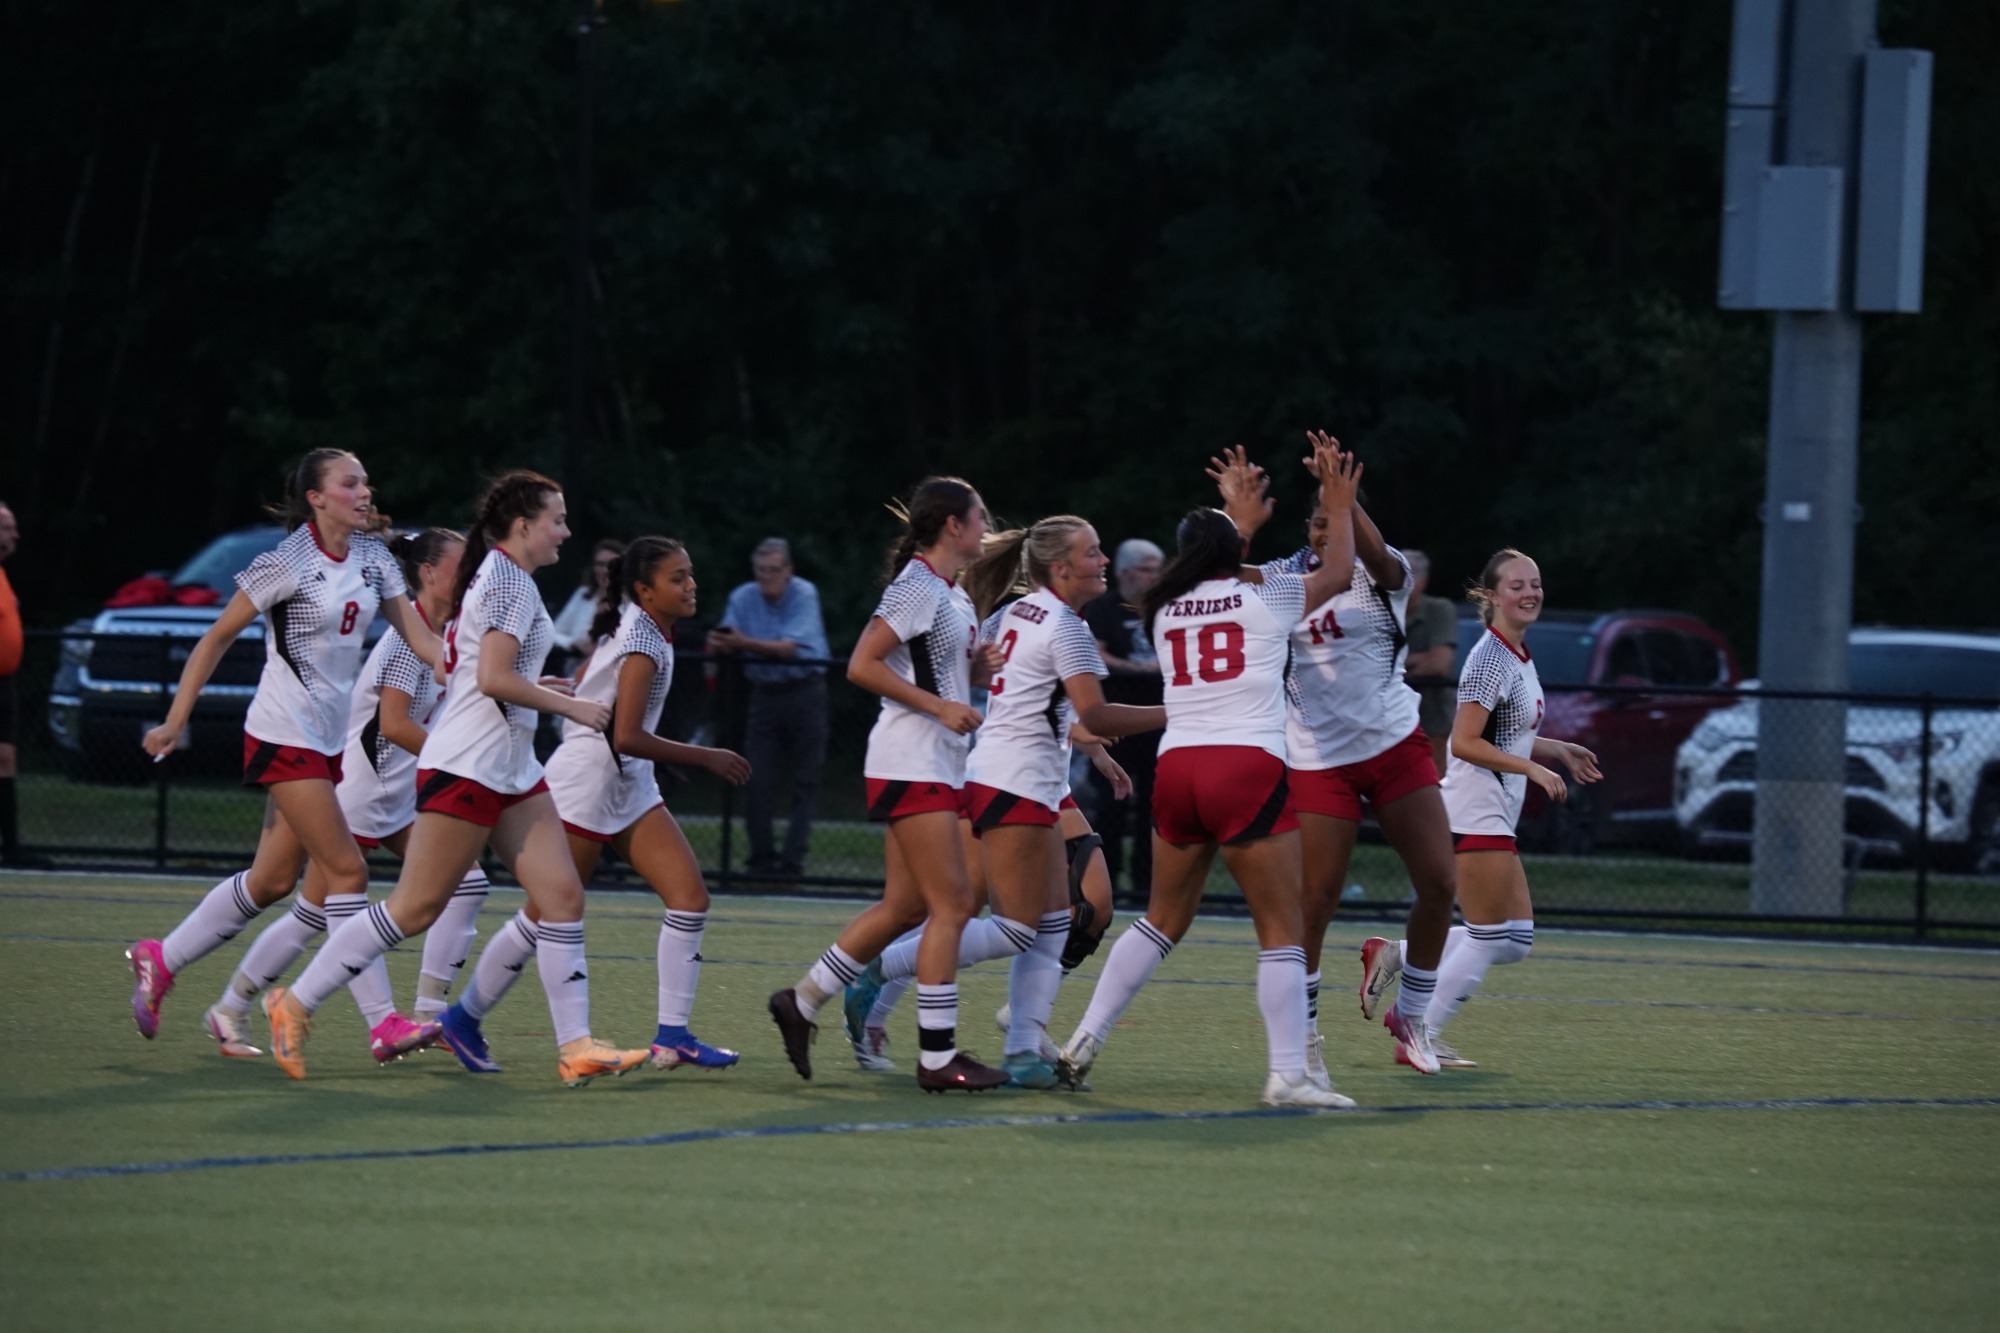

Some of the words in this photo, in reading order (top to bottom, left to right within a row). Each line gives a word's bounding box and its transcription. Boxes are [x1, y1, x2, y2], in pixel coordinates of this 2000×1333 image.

[340, 601, 359, 635] 8
[1165, 594, 1242, 617] TERRIERS
[1309, 609, 1345, 645] 14
[1164, 621, 1245, 687] 18
